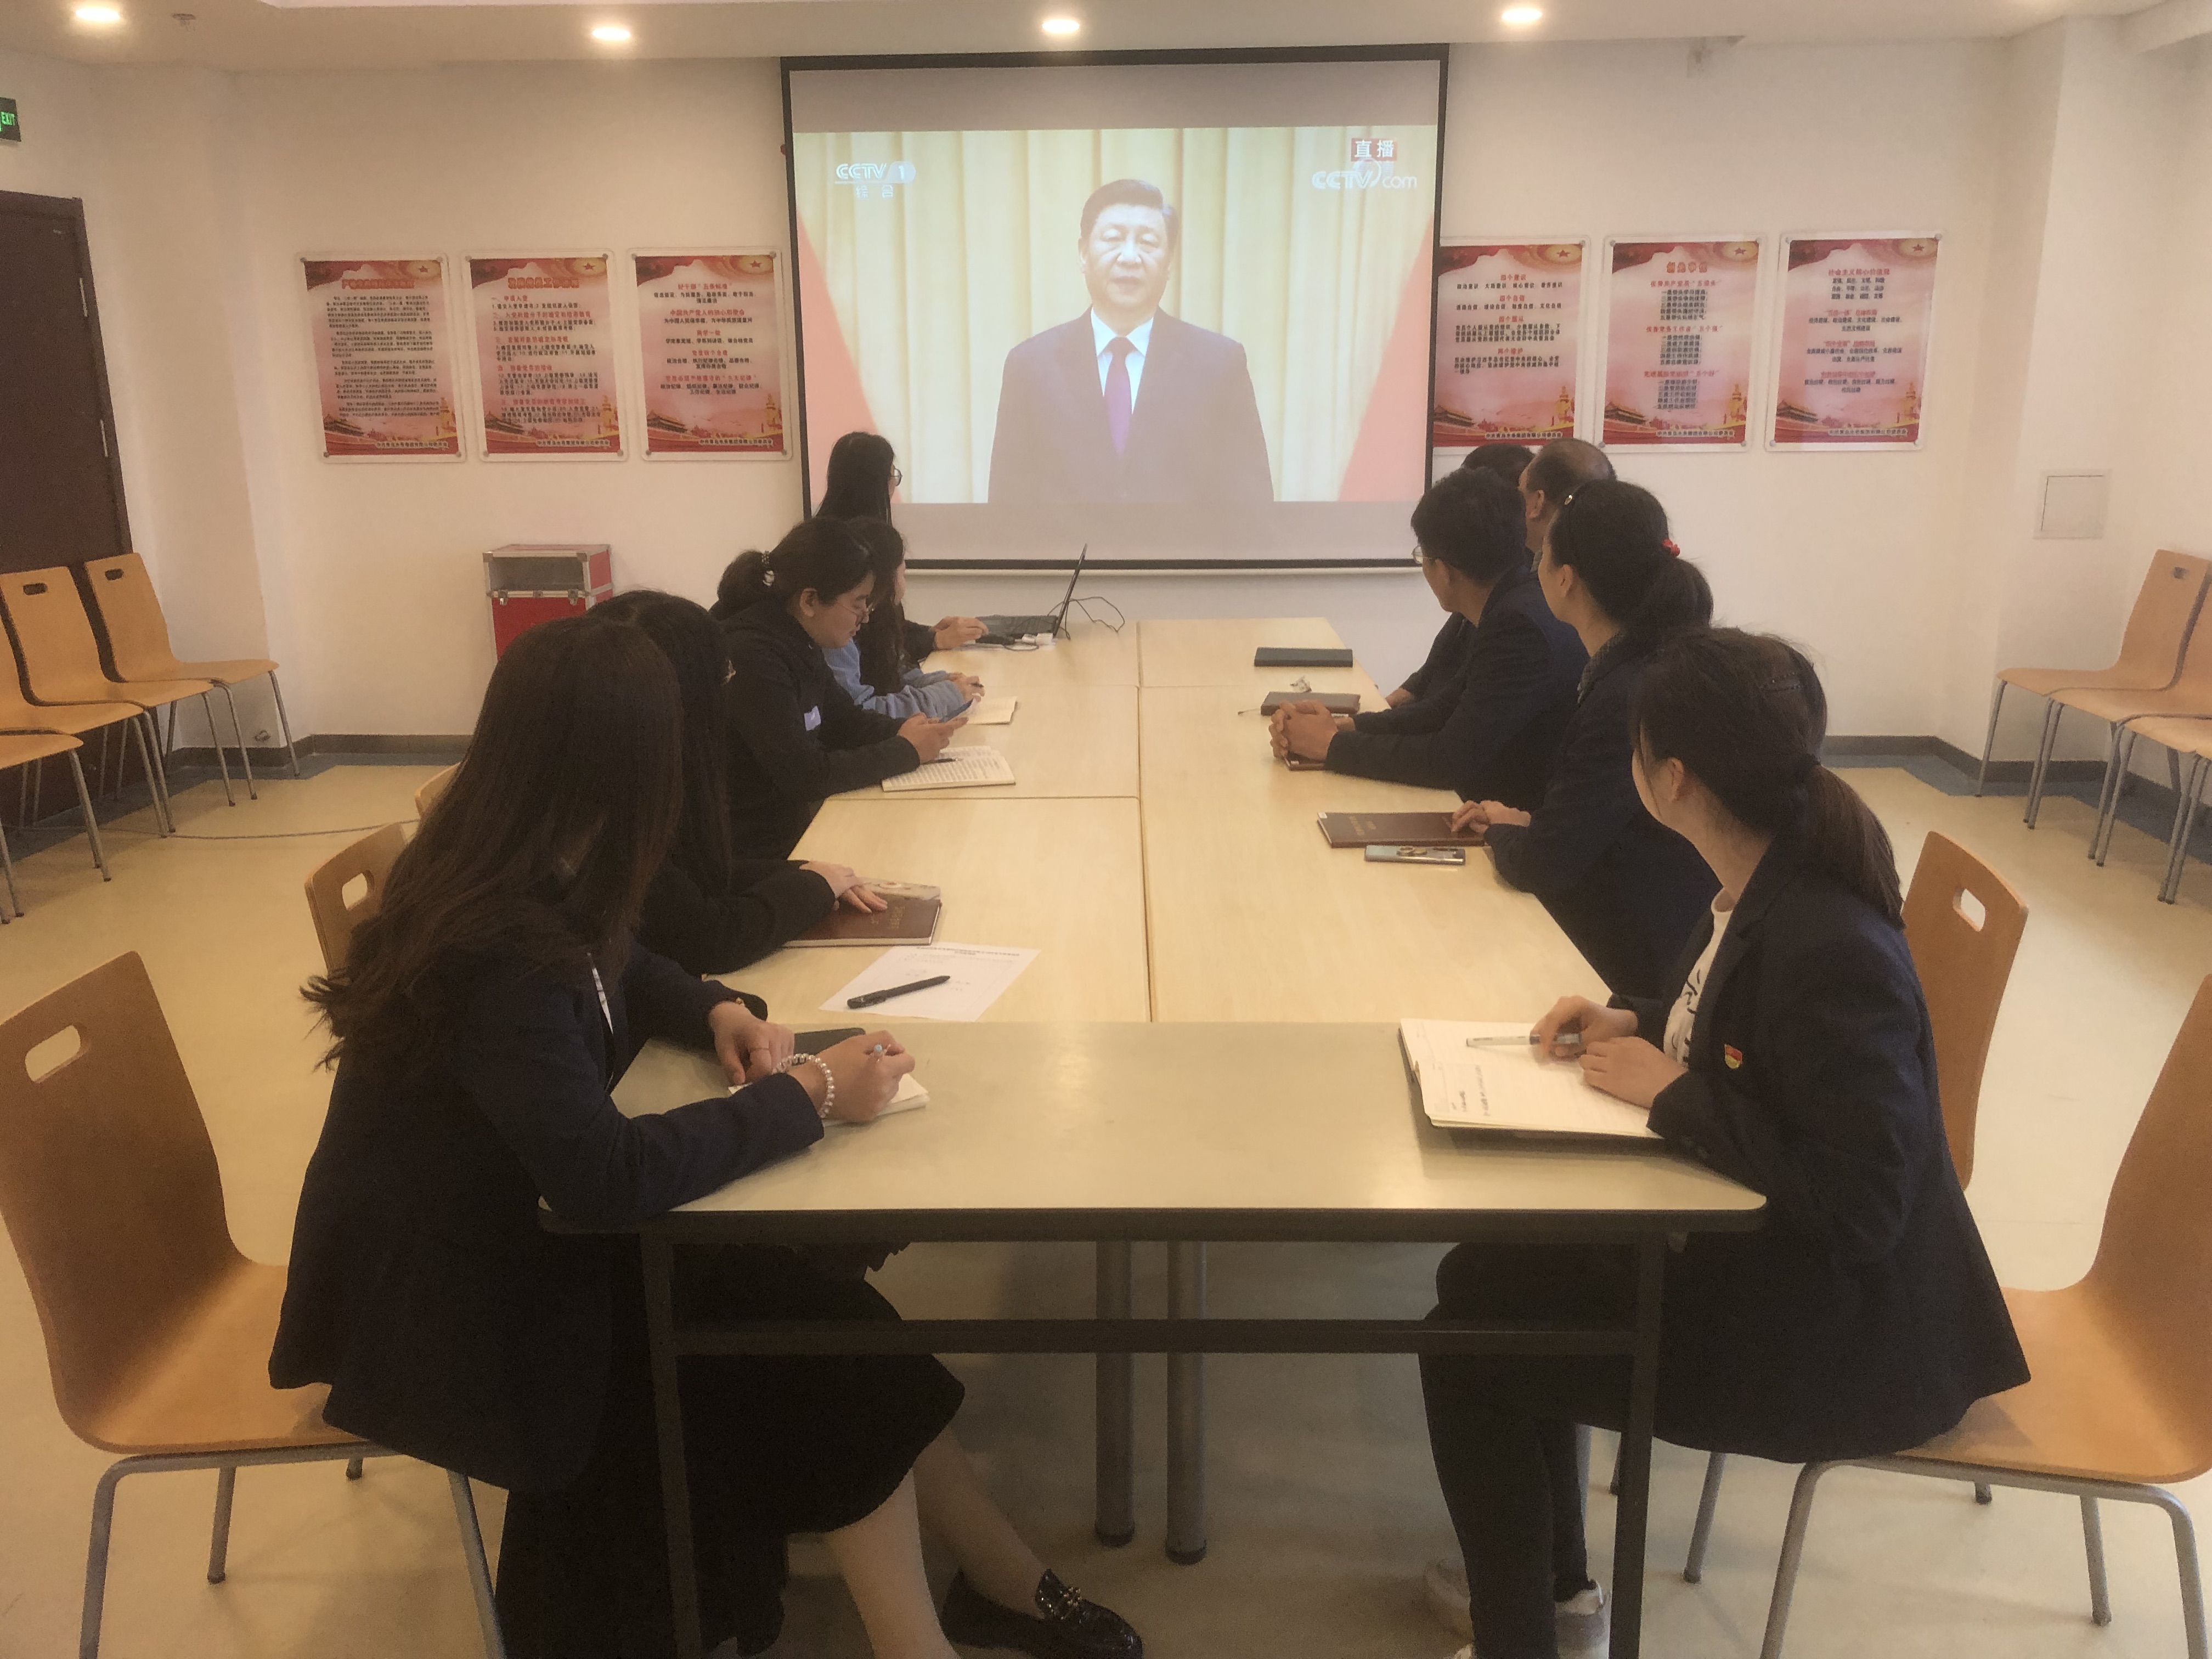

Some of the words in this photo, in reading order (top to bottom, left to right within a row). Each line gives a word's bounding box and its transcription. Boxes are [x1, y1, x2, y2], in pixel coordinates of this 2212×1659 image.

[1, 111, 15, 126] EXIT
[1355, 140, 1393, 157] 直播
[836, 163, 887, 179] CCTV
[1312, 171, 1373, 189] CCTV
